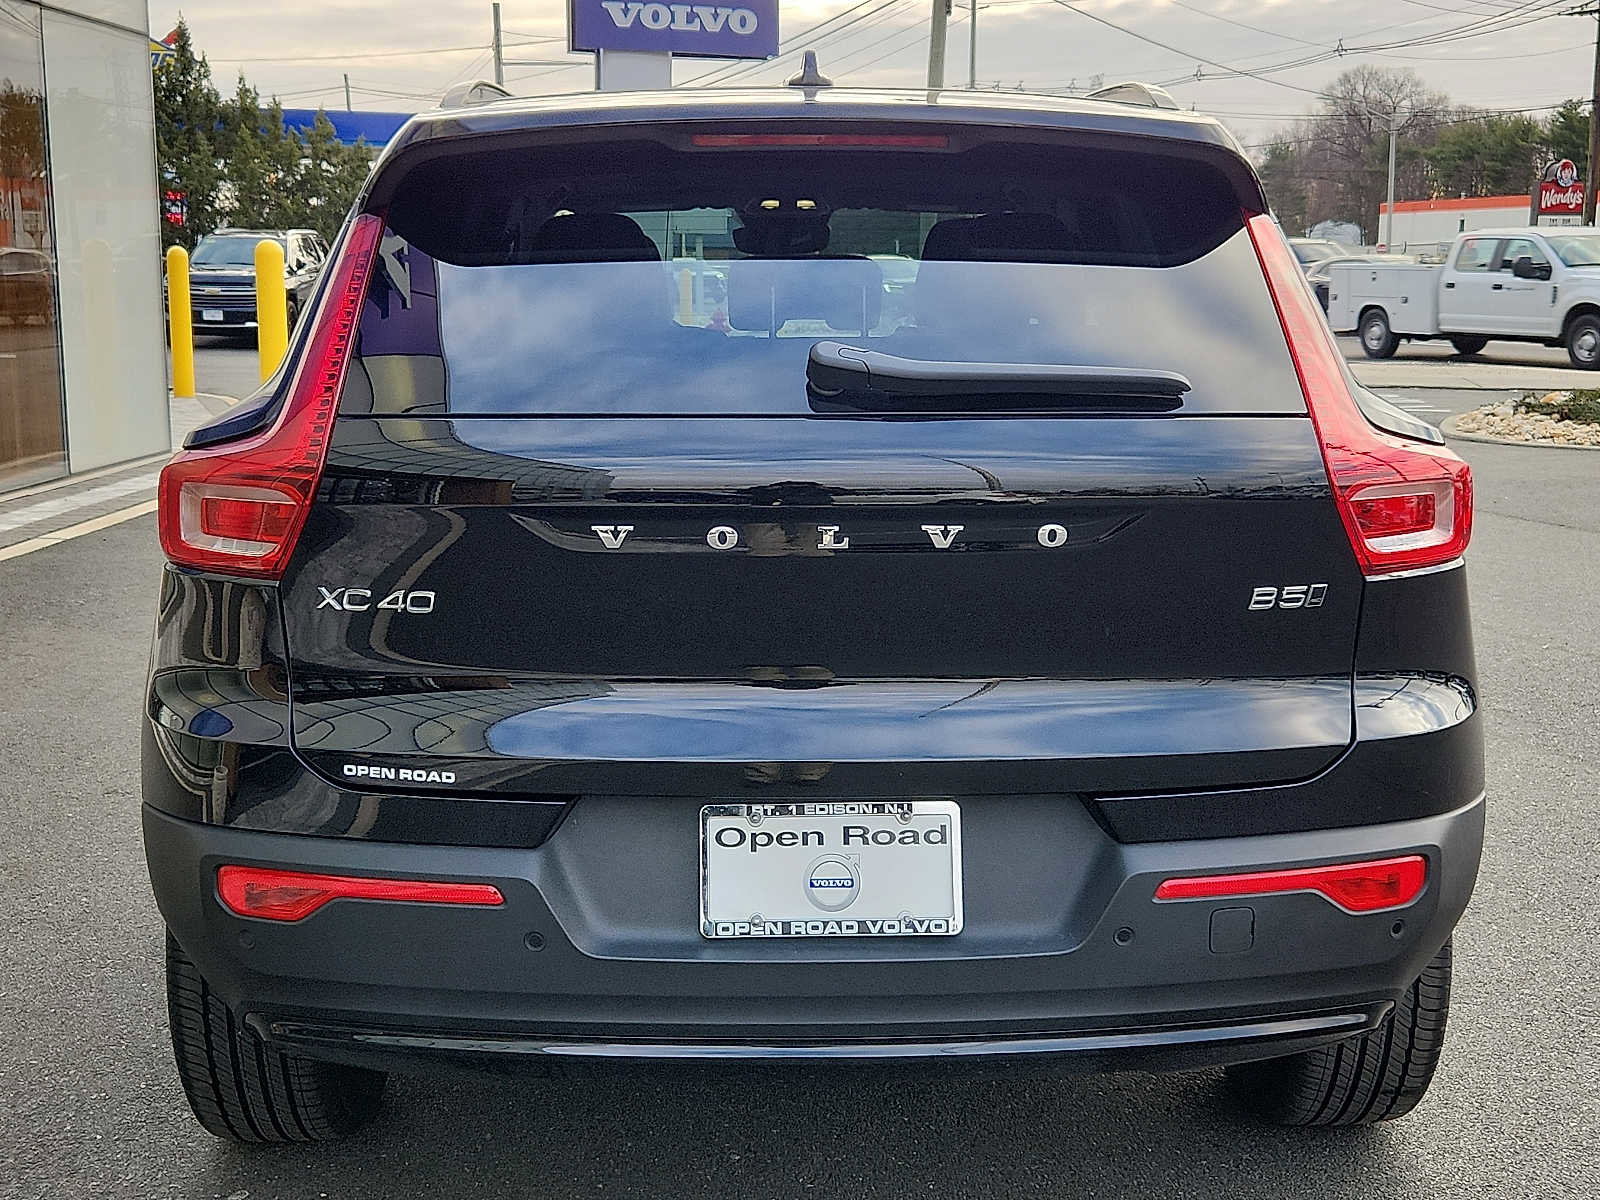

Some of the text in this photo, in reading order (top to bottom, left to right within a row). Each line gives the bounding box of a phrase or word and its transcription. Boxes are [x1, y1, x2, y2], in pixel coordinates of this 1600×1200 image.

[601, 2, 758, 35] VOLVO
[1541, 187, 1583, 209] Wendy's
[343, 764, 456, 784] OPEN ROAD
[788, 805, 797, 816] 1
[714, 825, 948, 852] Open Road
[812, 879, 852, 887] VOLVO
[716, 919, 947, 936] OPEN ROAD VOLVO
